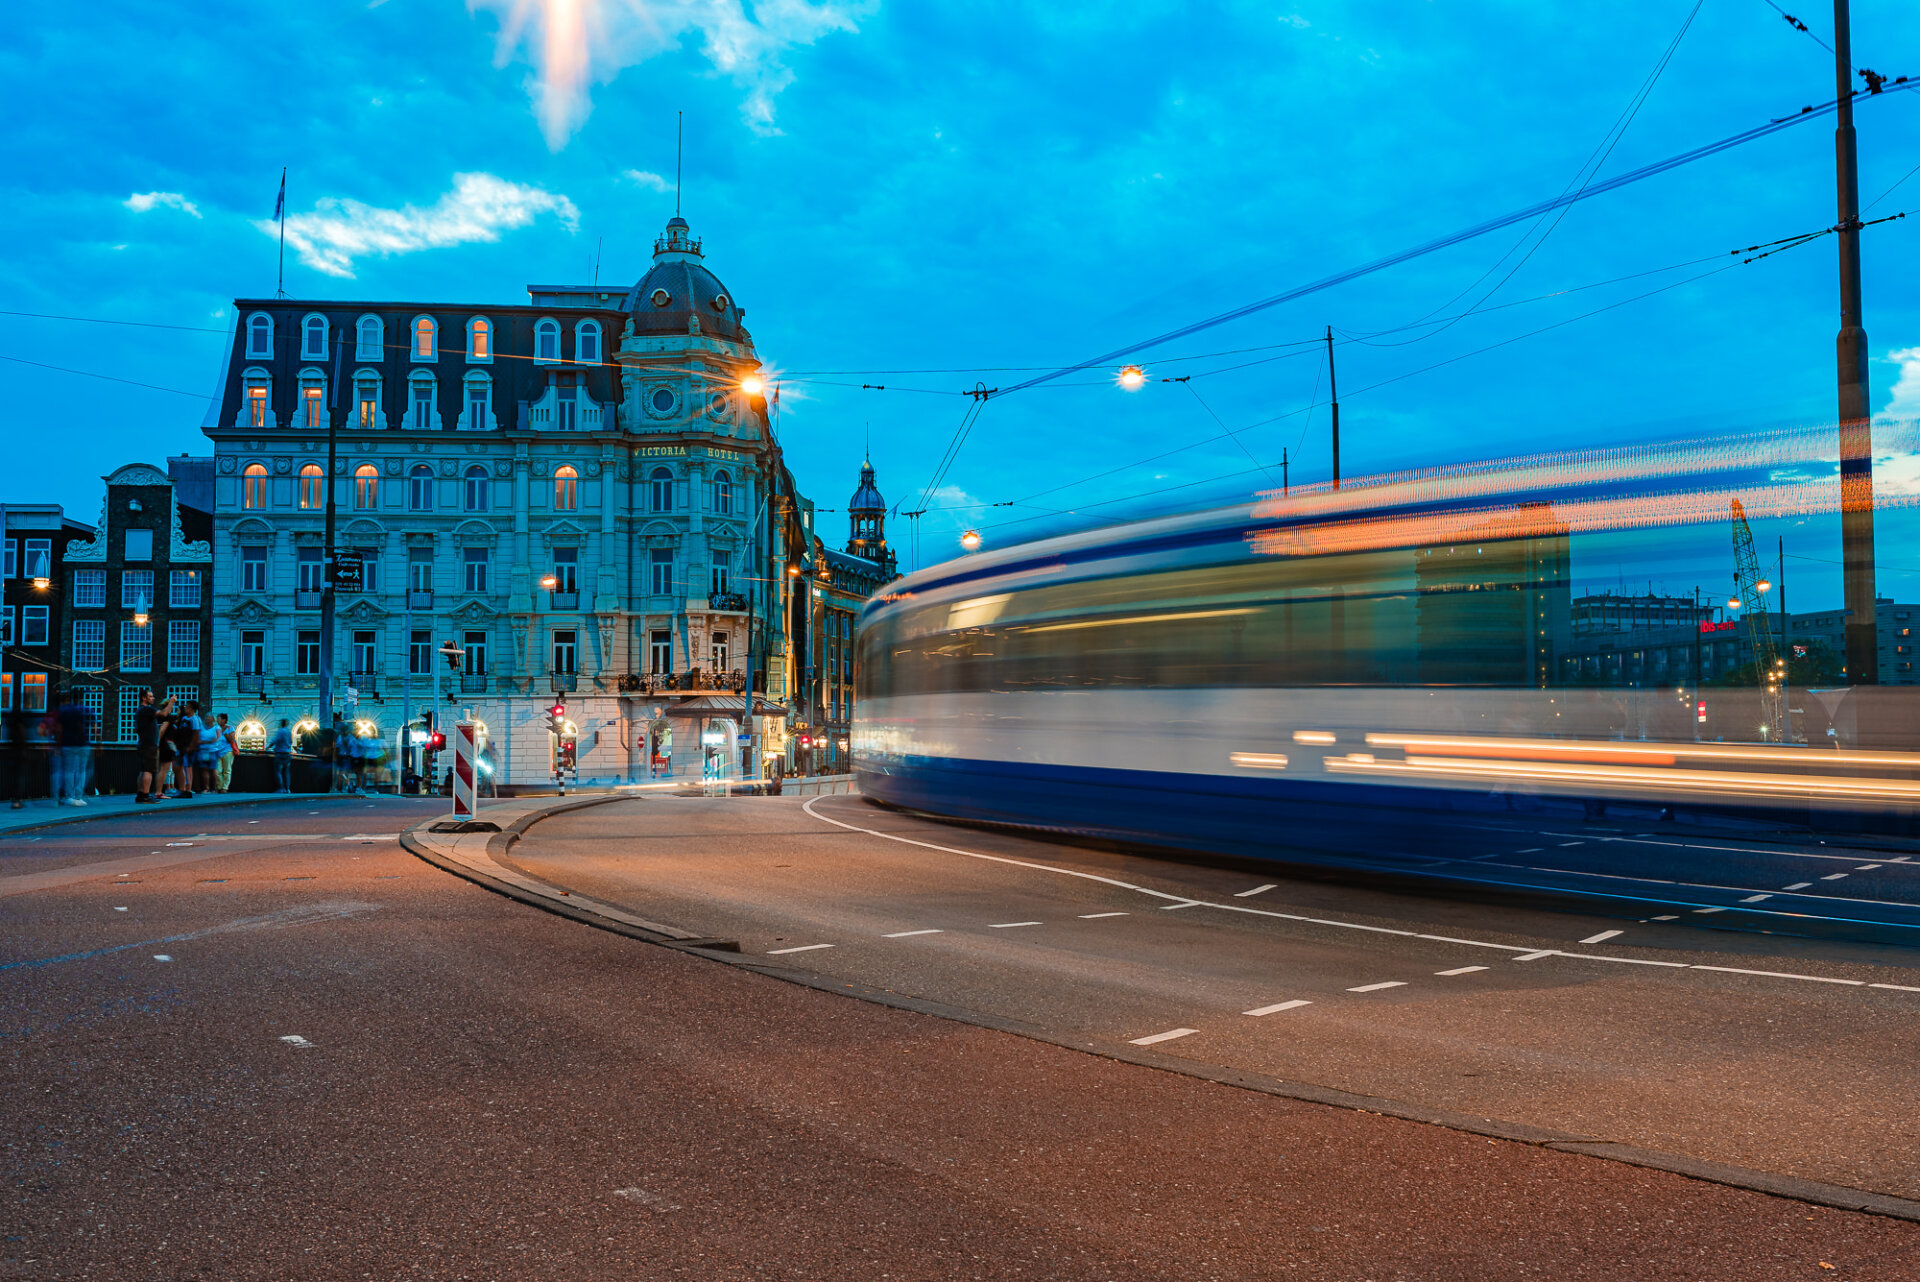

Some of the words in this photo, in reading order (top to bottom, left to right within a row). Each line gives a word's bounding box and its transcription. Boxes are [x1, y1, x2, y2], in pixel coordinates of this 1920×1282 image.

[634, 446, 686, 456] VICTORIA
[707, 447, 739, 460] HOTEL
[1700, 619, 1716, 633] ibis
[1717, 621, 1736, 630] HOTEL
